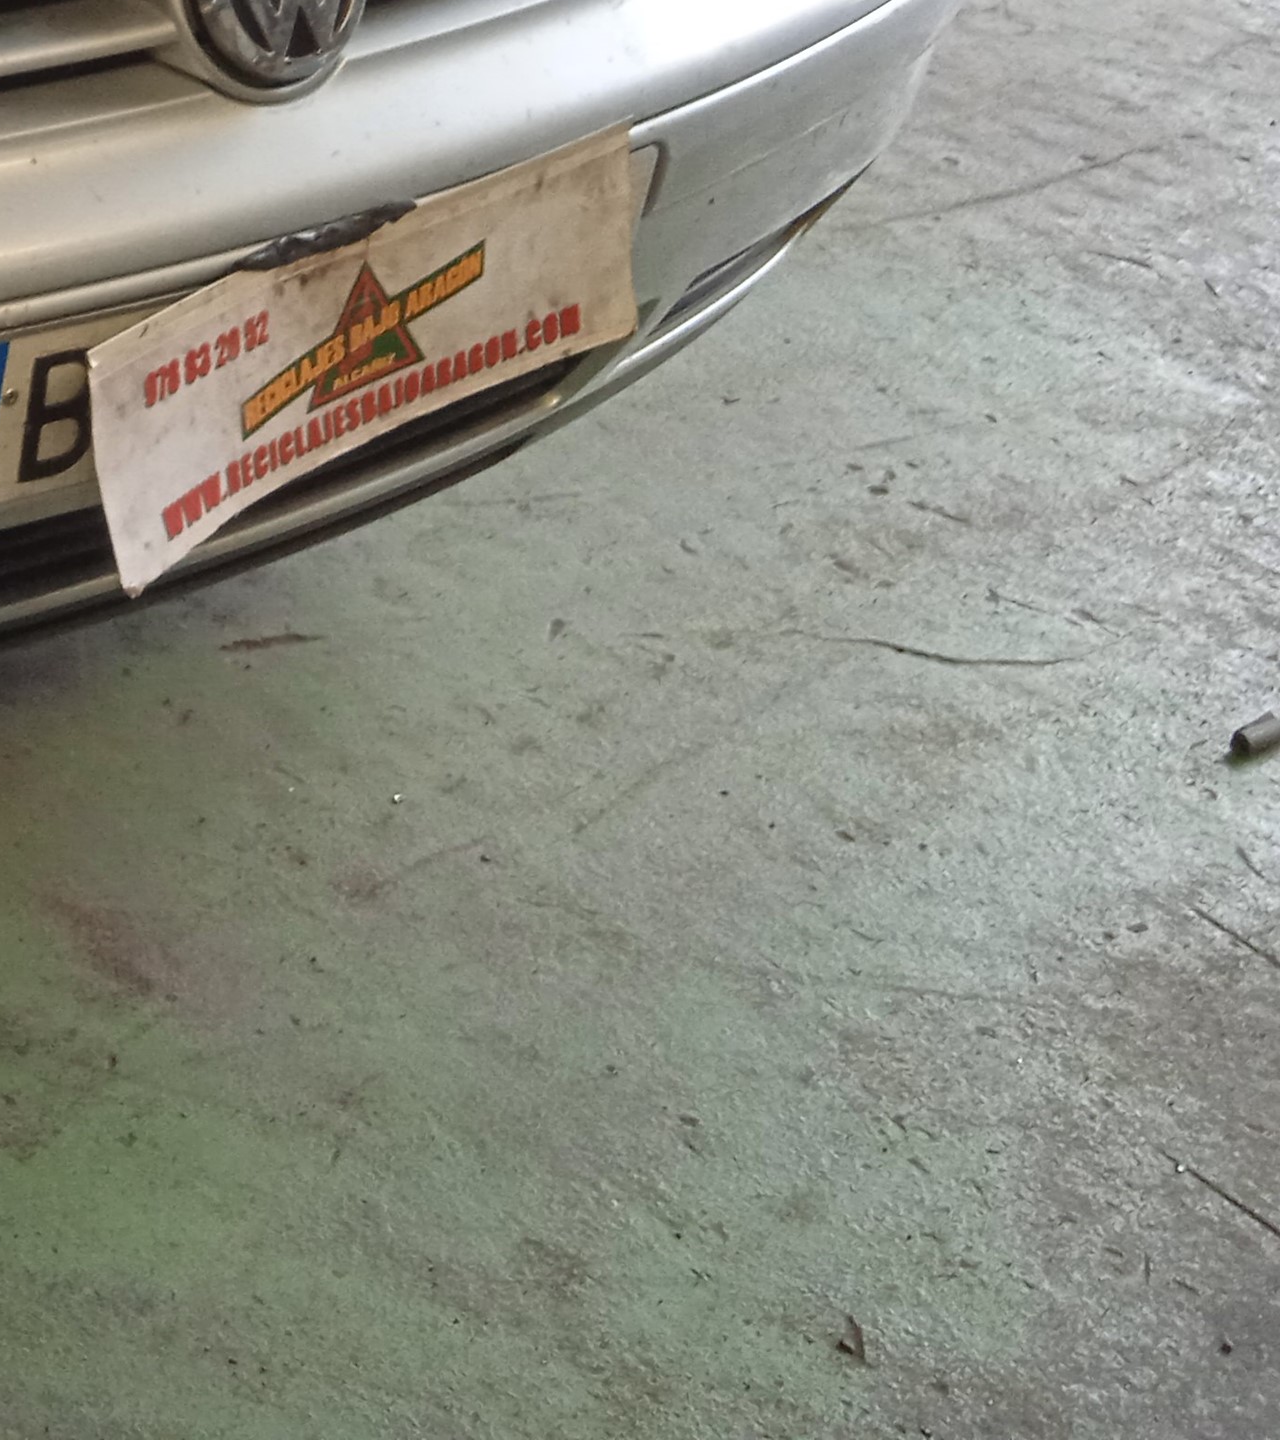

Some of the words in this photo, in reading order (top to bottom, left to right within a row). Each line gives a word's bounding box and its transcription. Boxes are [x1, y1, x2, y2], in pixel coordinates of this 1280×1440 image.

[143, 357, 181, 408] 978
[184, 341, 212, 385] 83
[244, 309, 270, 353] 52
[161, 302, 581, 541] WWW.RECICLAJESBAJOARAGON.COM
[244, 334, 346, 431] RECICLAJES
[349, 300, 401, 353] BAJO
